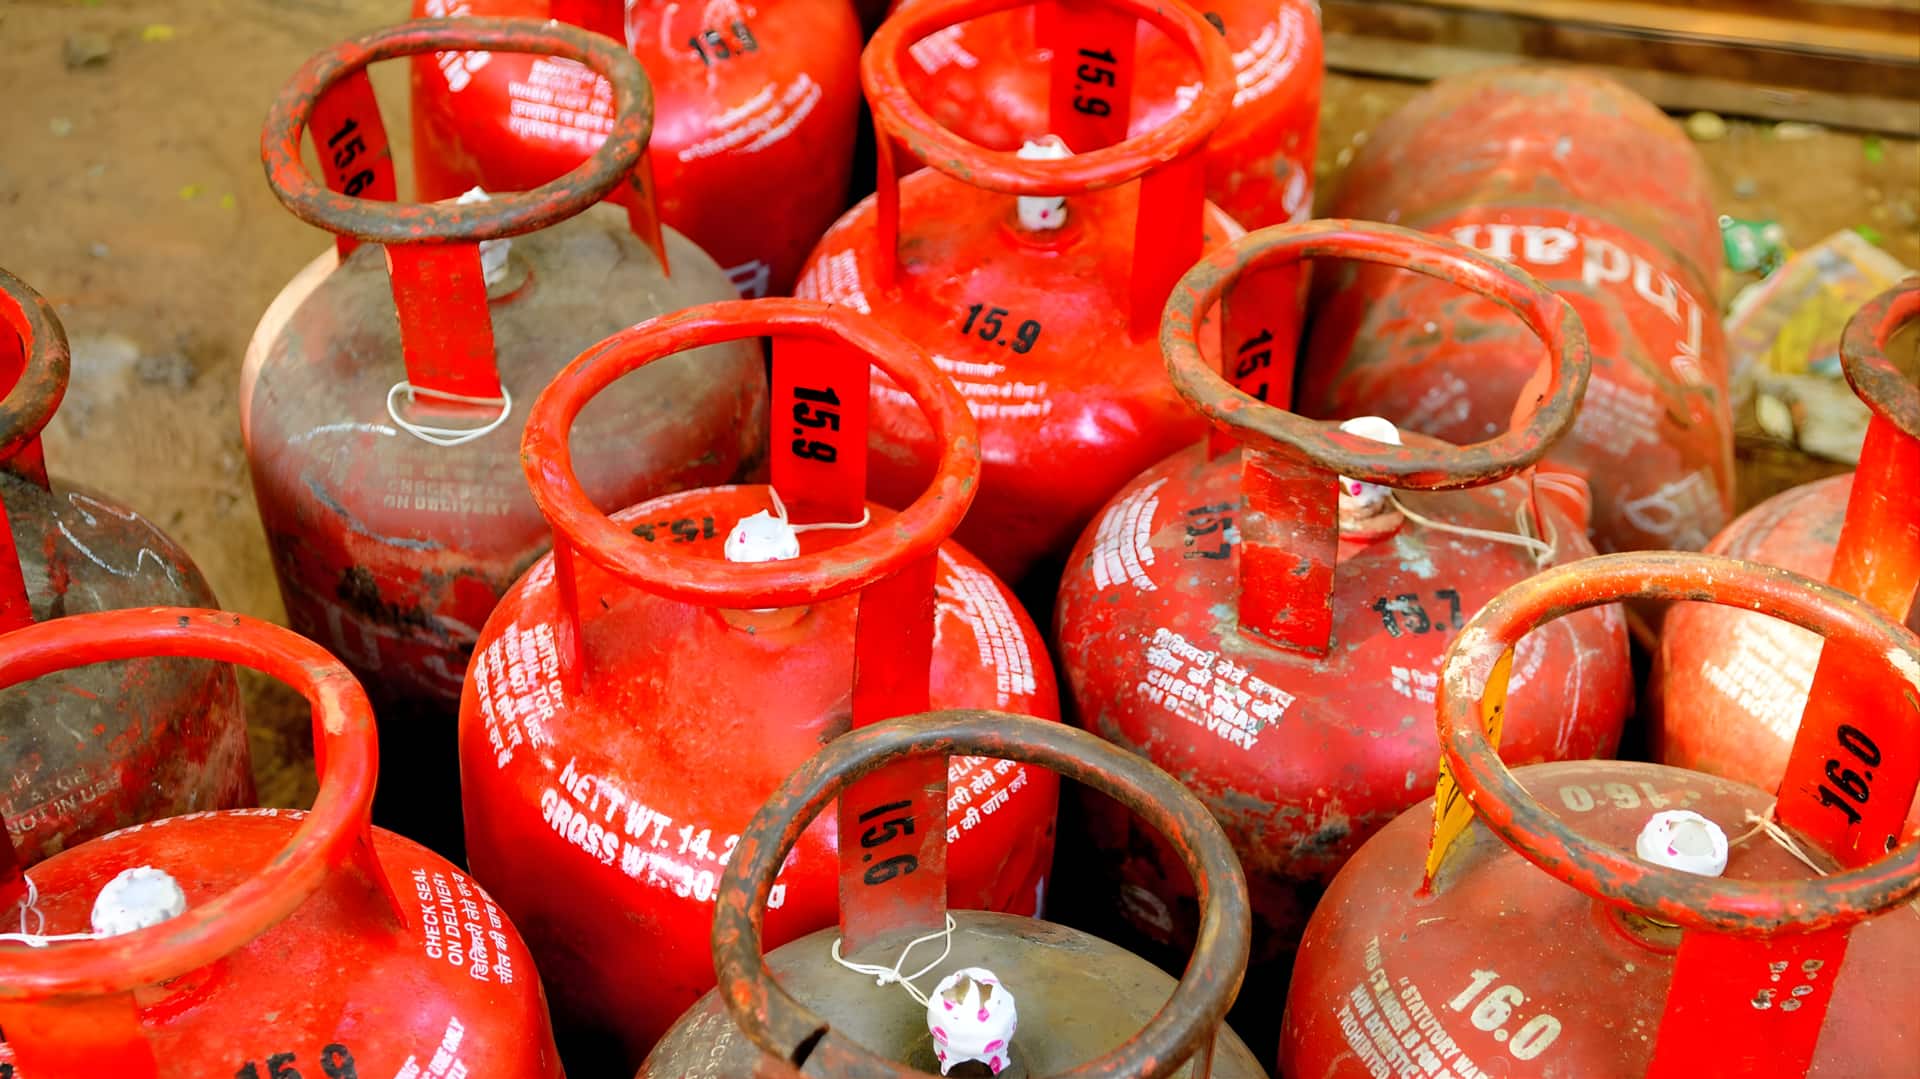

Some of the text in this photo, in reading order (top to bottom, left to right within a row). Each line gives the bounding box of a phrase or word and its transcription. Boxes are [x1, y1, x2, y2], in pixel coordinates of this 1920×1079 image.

[1073, 48, 1117, 117] 15.9
[328, 117, 376, 197] 15.6
[961, 303, 1042, 354] 15.9
[1452, 222, 1706, 387] Indan
[792, 386, 841, 463] 15.9
[559, 755, 627, 824] NETT
[624, 800, 673, 850] WT.
[1558, 781, 1671, 813] 16.0
[1817, 724, 1882, 825] 16.0
[540, 788, 620, 867] GROSS
[858, 799, 919, 886] 15.6
[412, 868, 444, 959] CHECK SEAL
[447, 940, 465, 967] ON
[1449, 968, 1562, 1061] 16.0
